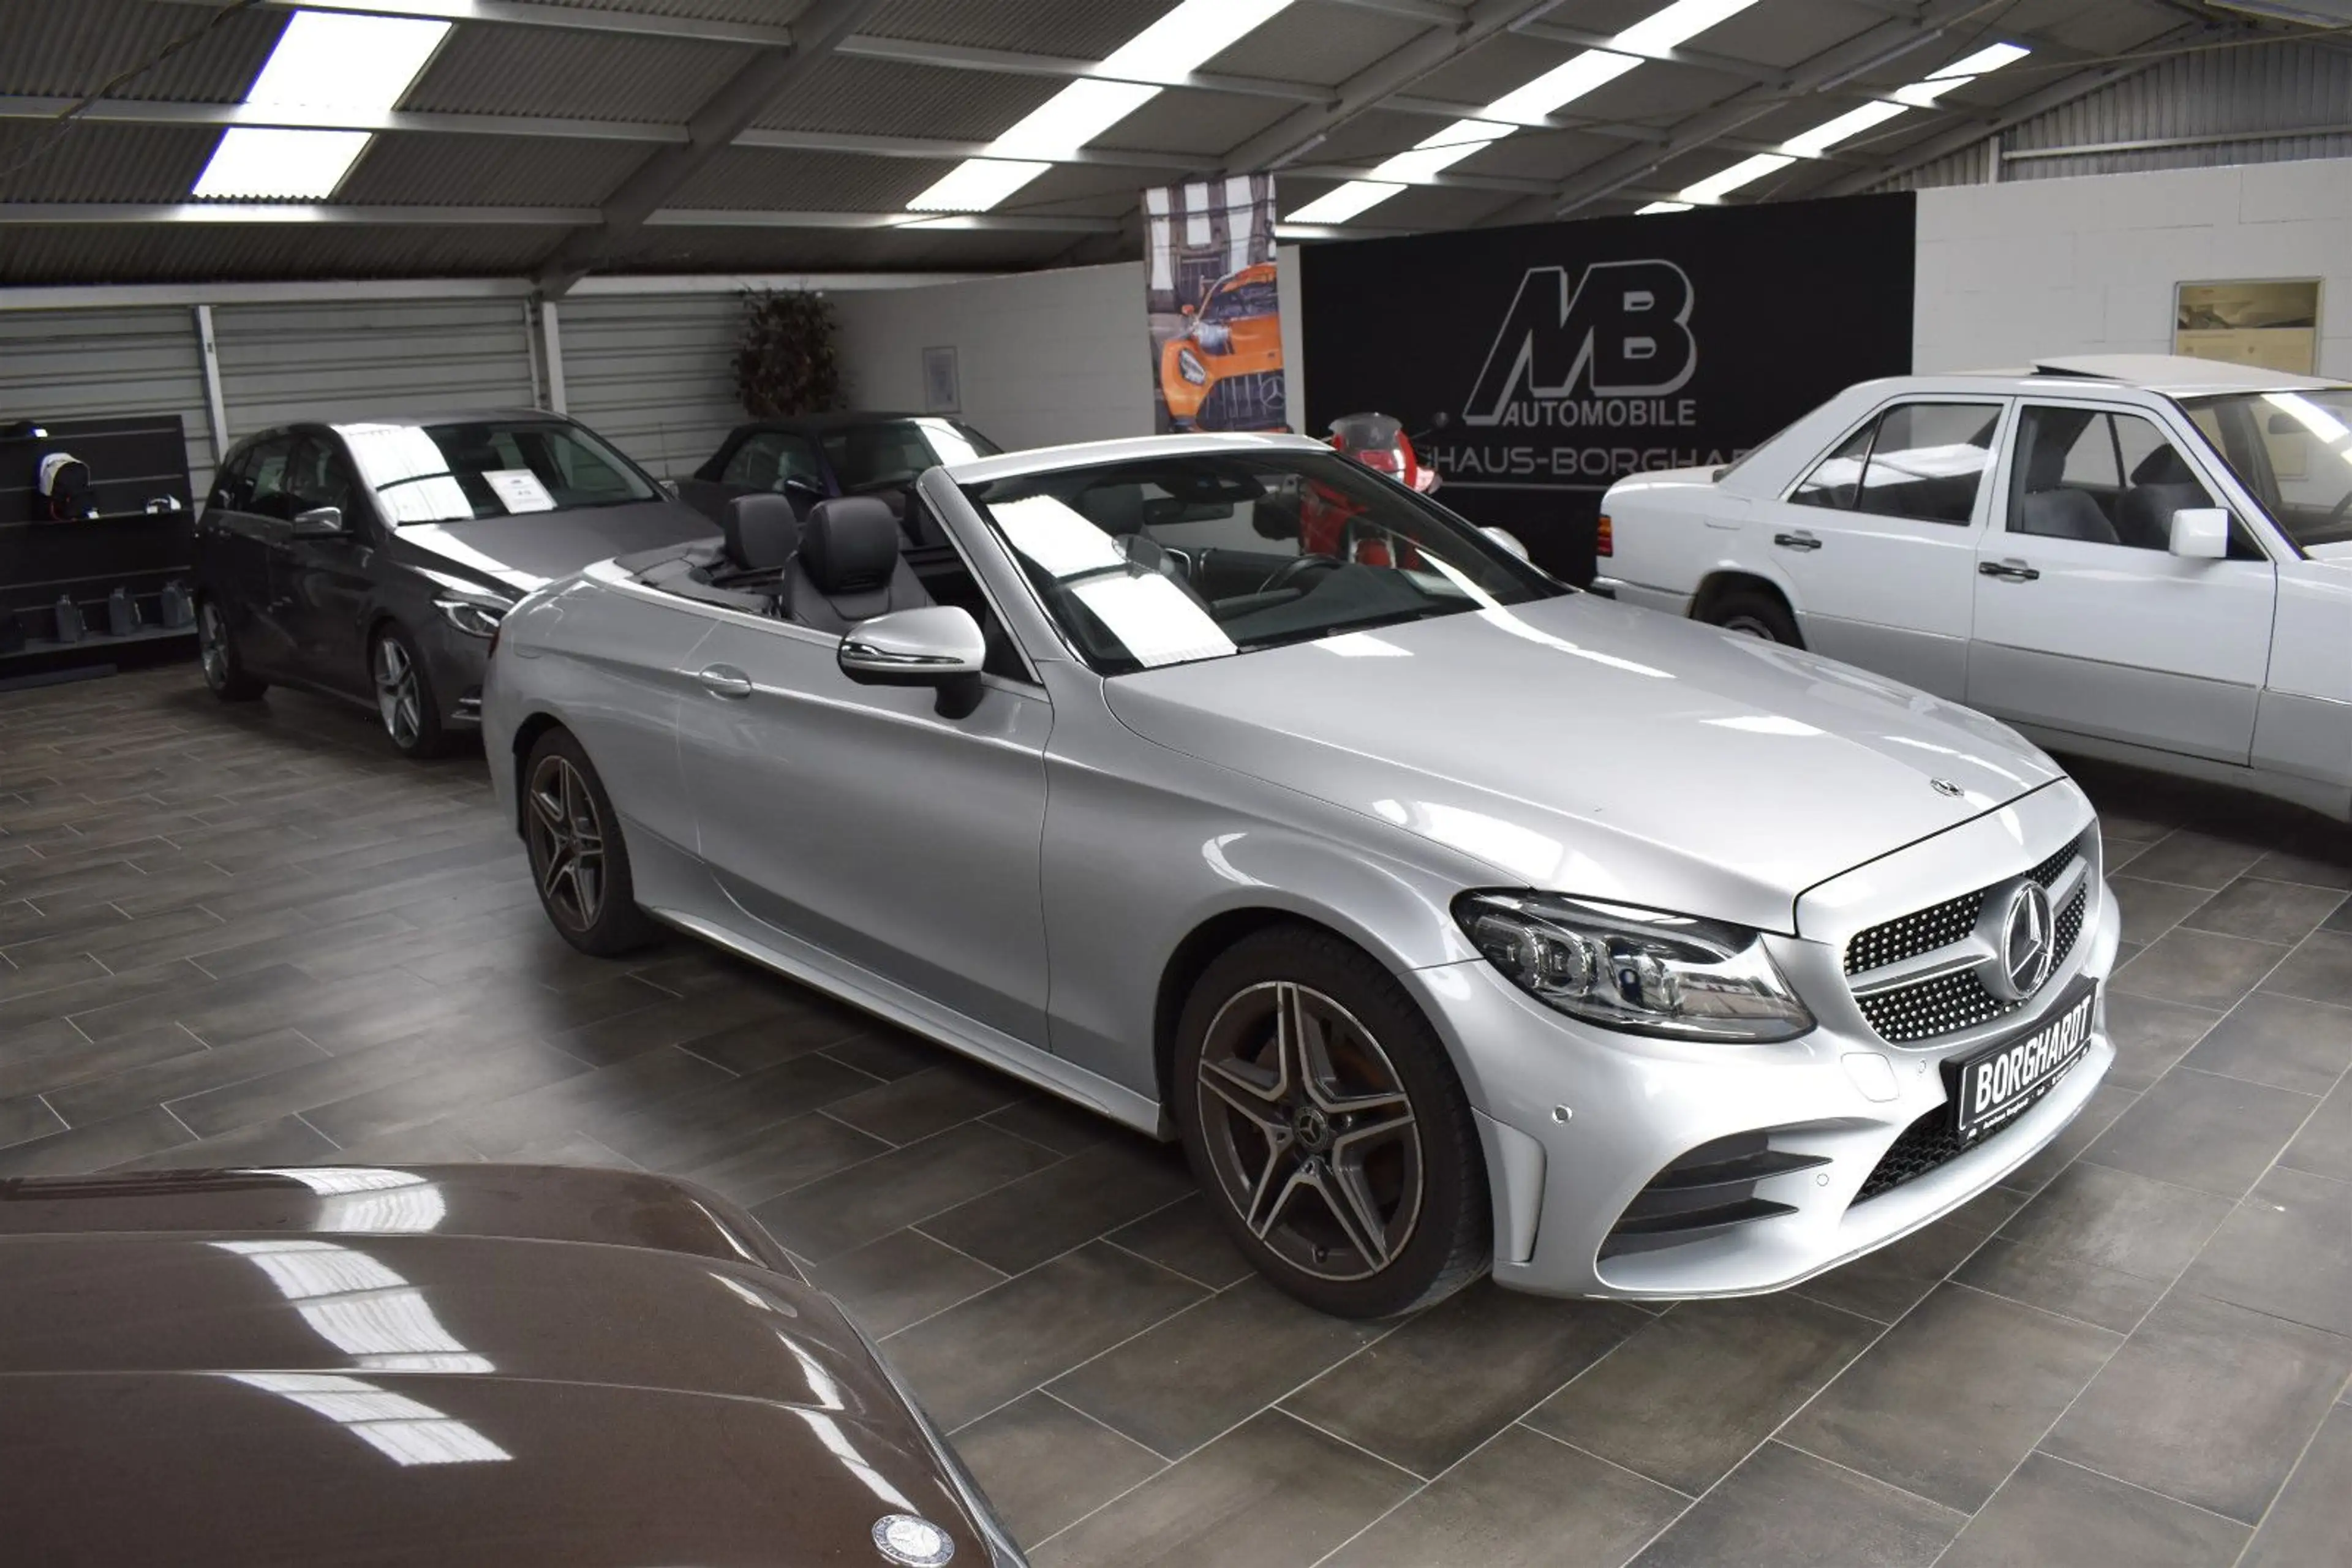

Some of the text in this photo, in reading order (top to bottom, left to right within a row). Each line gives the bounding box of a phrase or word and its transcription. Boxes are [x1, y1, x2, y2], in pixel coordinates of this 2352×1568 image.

[1464, 259, 1697, 425] MB
[1502, 399, 1696, 428] AUTOMOBILE
[1975, 994, 2091, 1114] BORGHARDT
